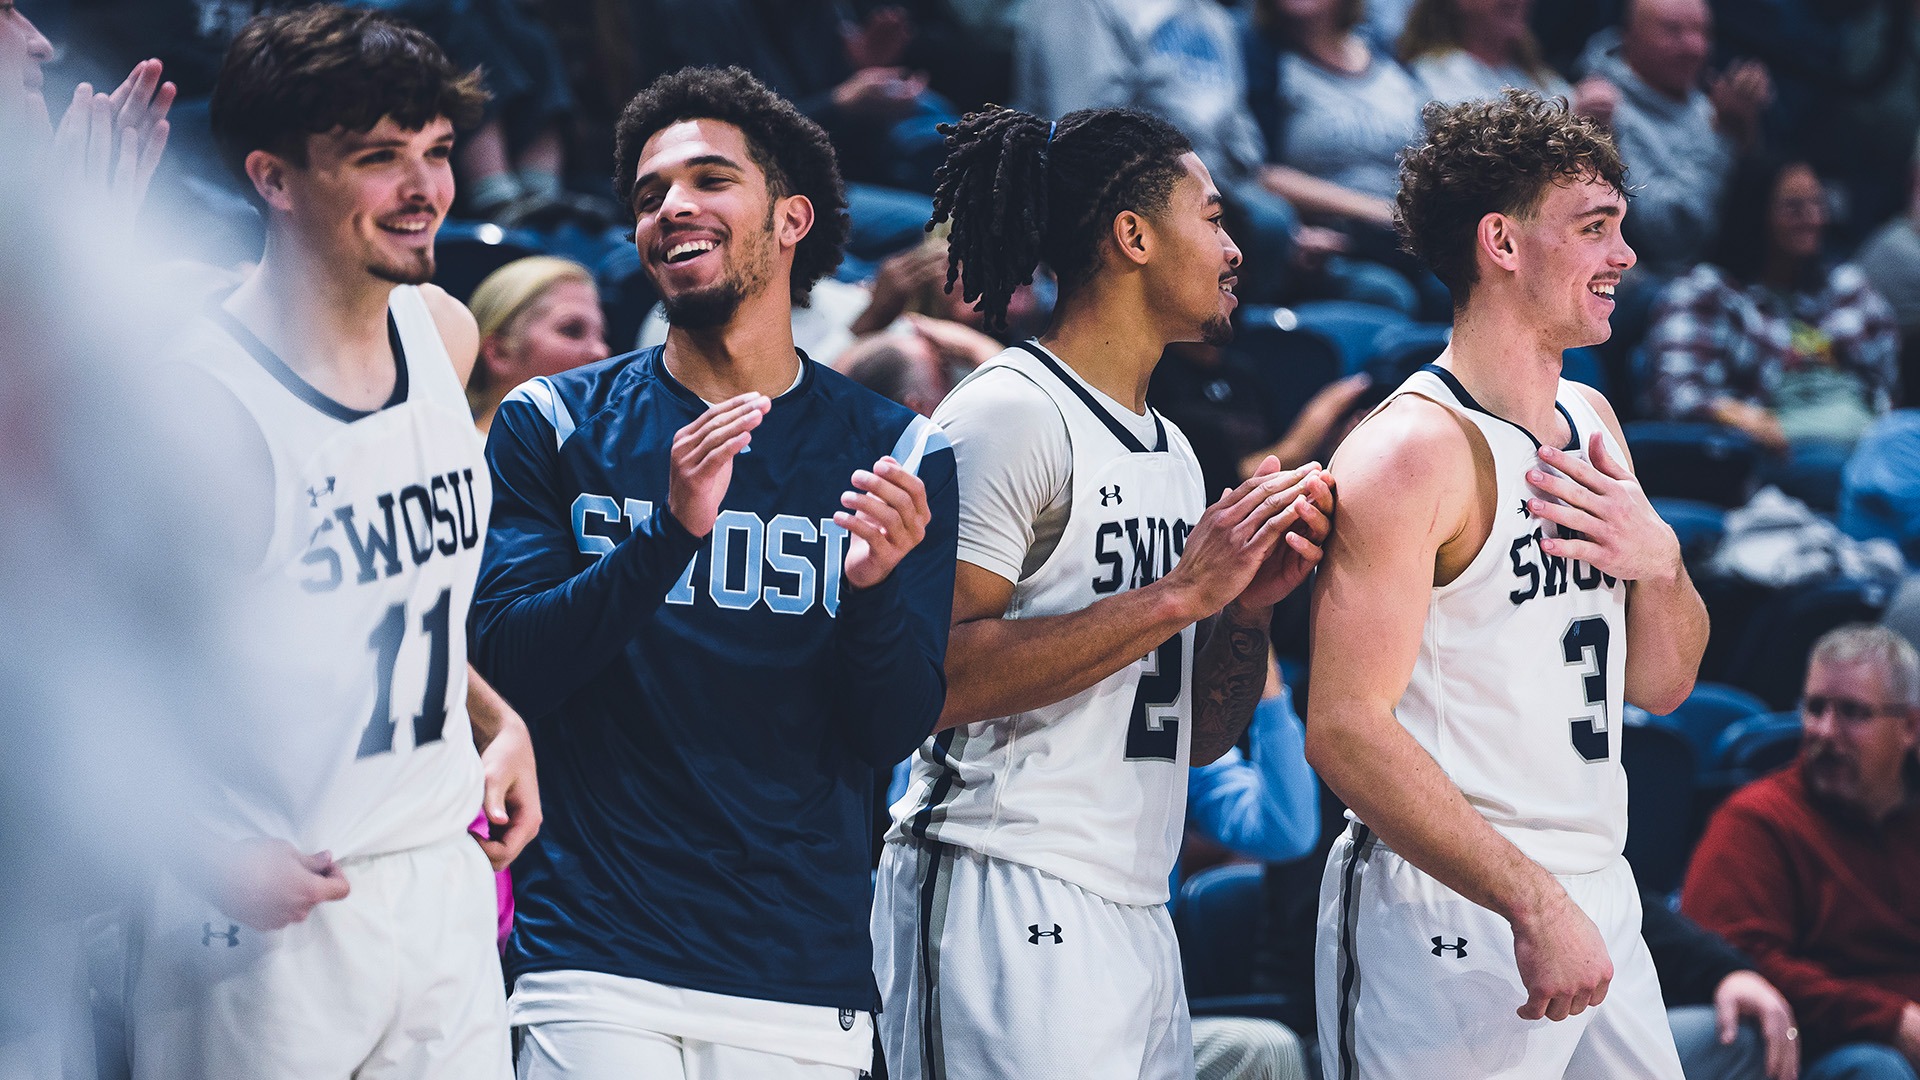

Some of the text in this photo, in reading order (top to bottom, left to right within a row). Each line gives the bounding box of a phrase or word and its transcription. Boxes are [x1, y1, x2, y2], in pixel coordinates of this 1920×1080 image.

[301, 468, 479, 594] SWOSU
[1092, 516, 1195, 595] SWOS
[355, 585, 451, 760] 11
[1123, 631, 1182, 763] 2
[1559, 614, 1610, 764] 3
